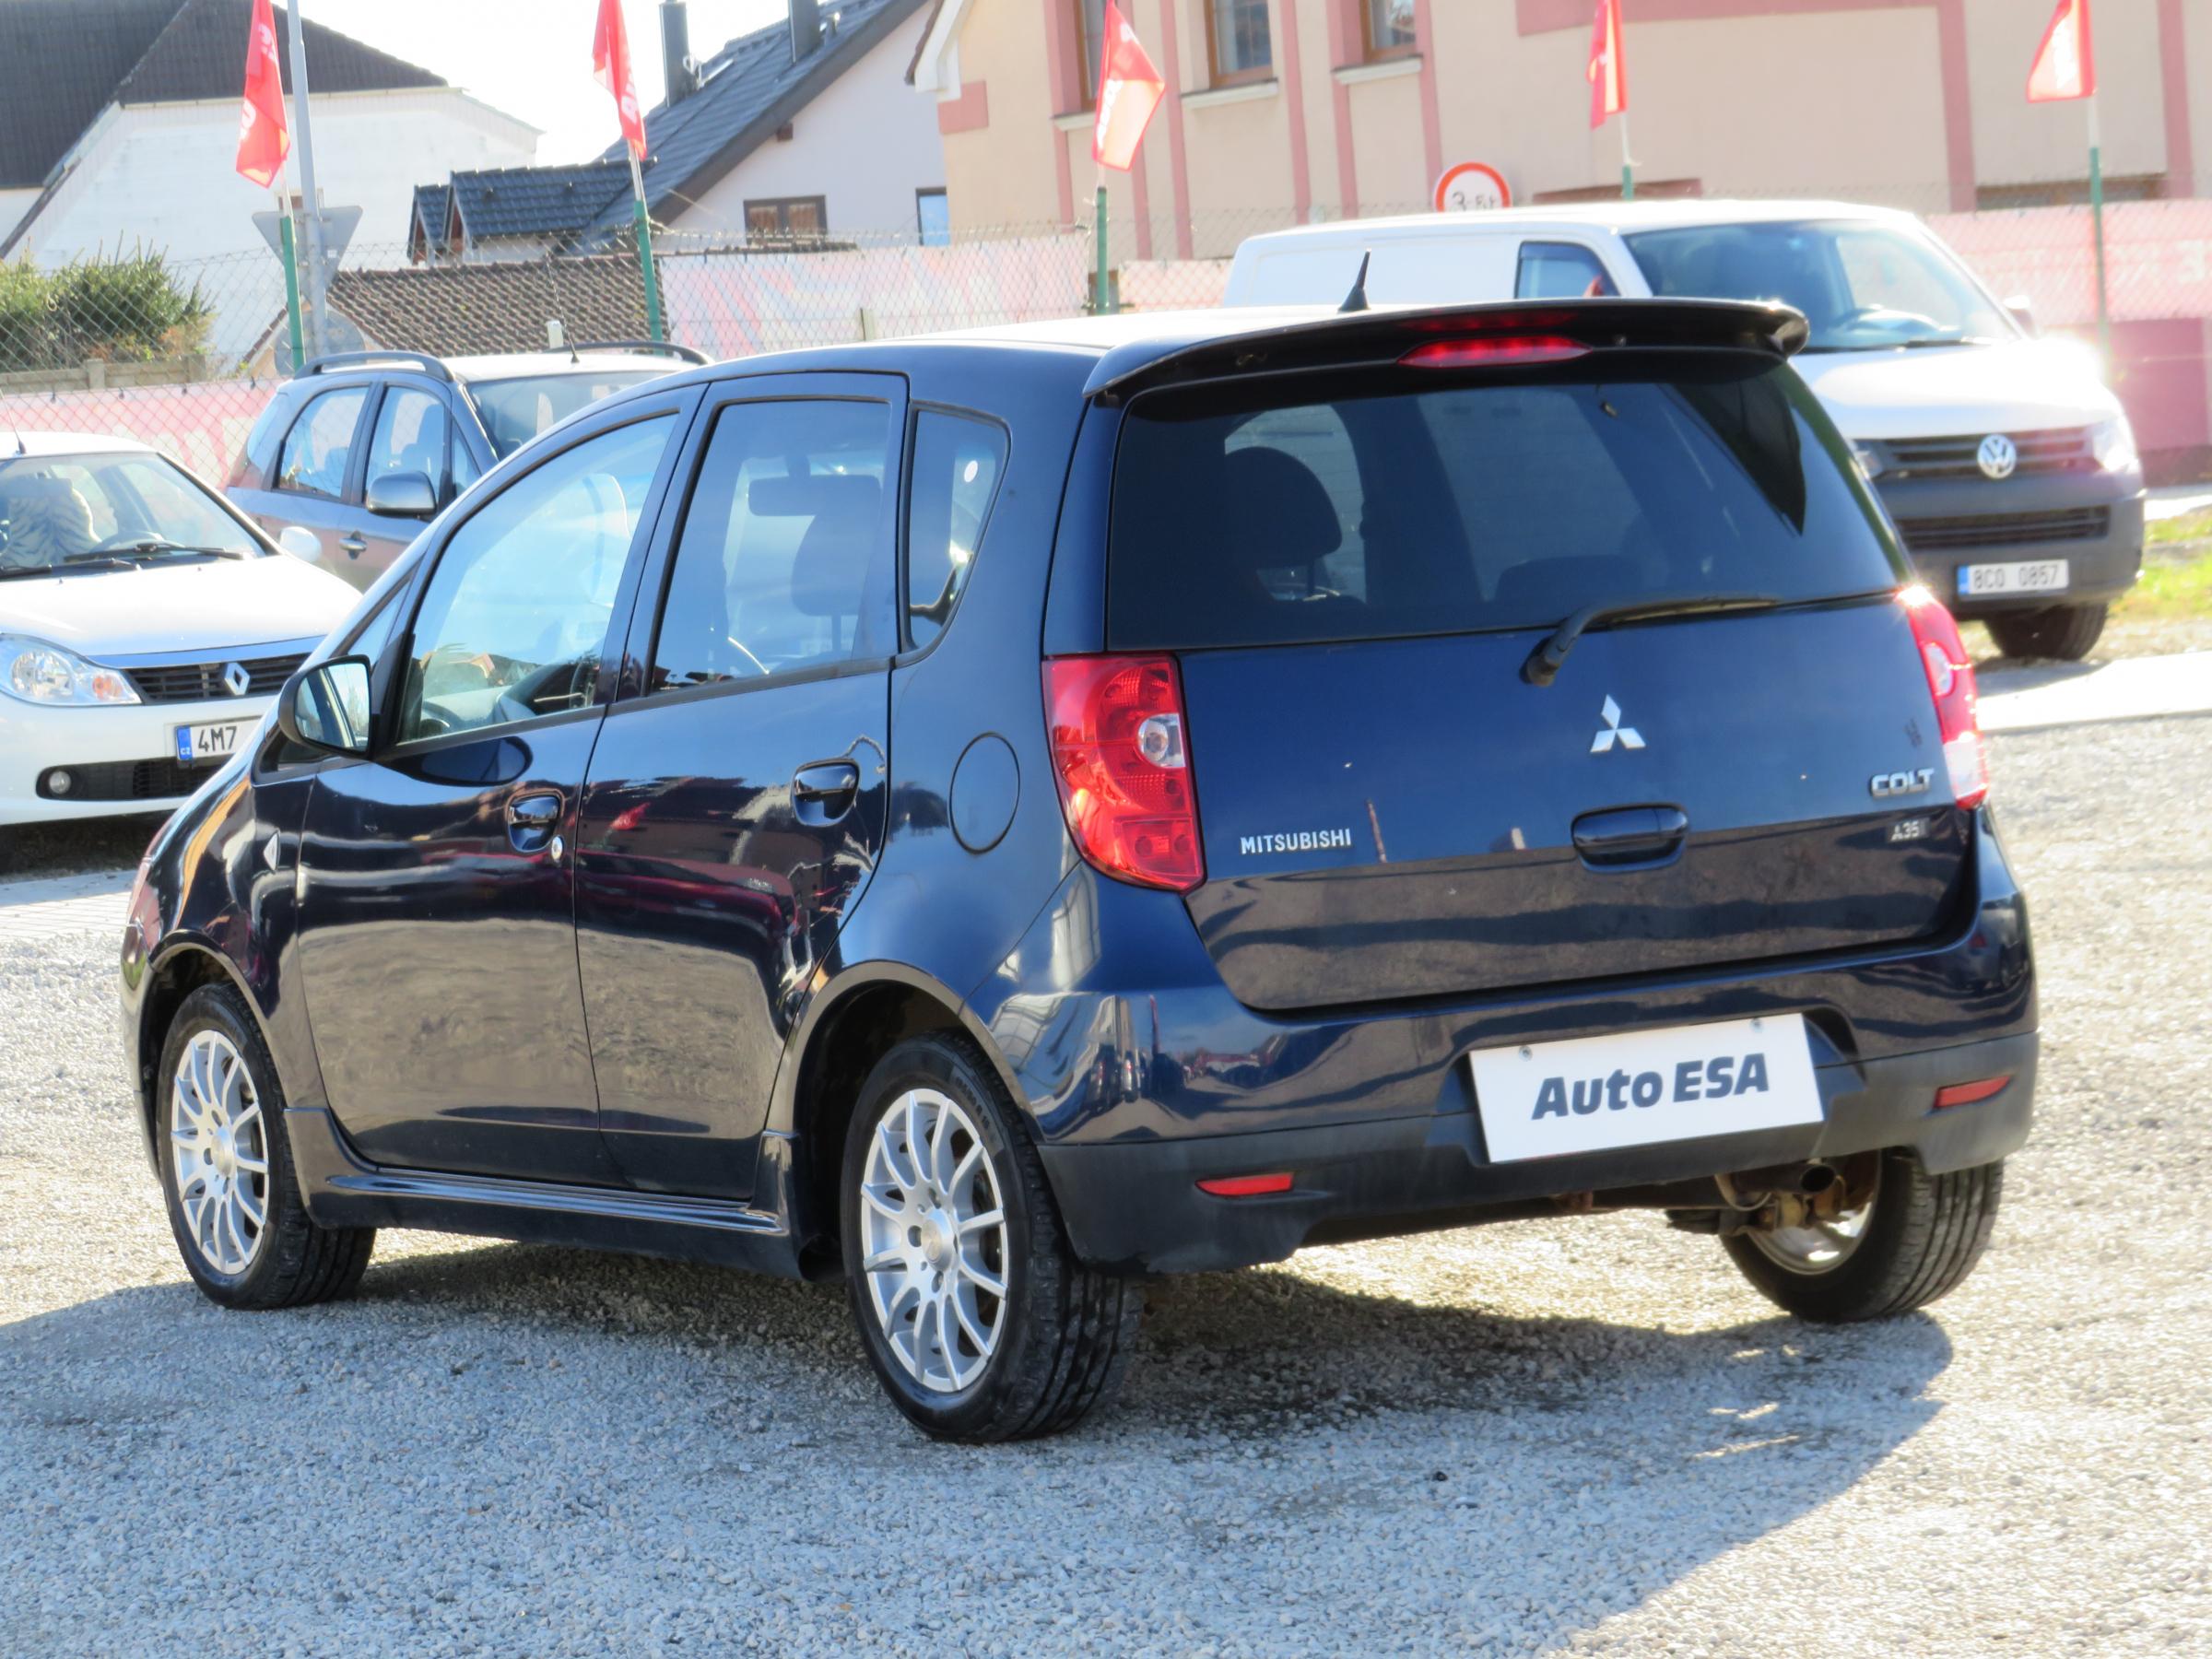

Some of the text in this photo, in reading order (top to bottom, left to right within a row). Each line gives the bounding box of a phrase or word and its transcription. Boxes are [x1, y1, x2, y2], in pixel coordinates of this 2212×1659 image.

[198, 725, 237, 752] 4M7
[1871, 767, 1935, 798] COLT
[1240, 828, 1352, 854] MITSUBISHI
[1531, 1053, 1770, 1121] Auto ESA
